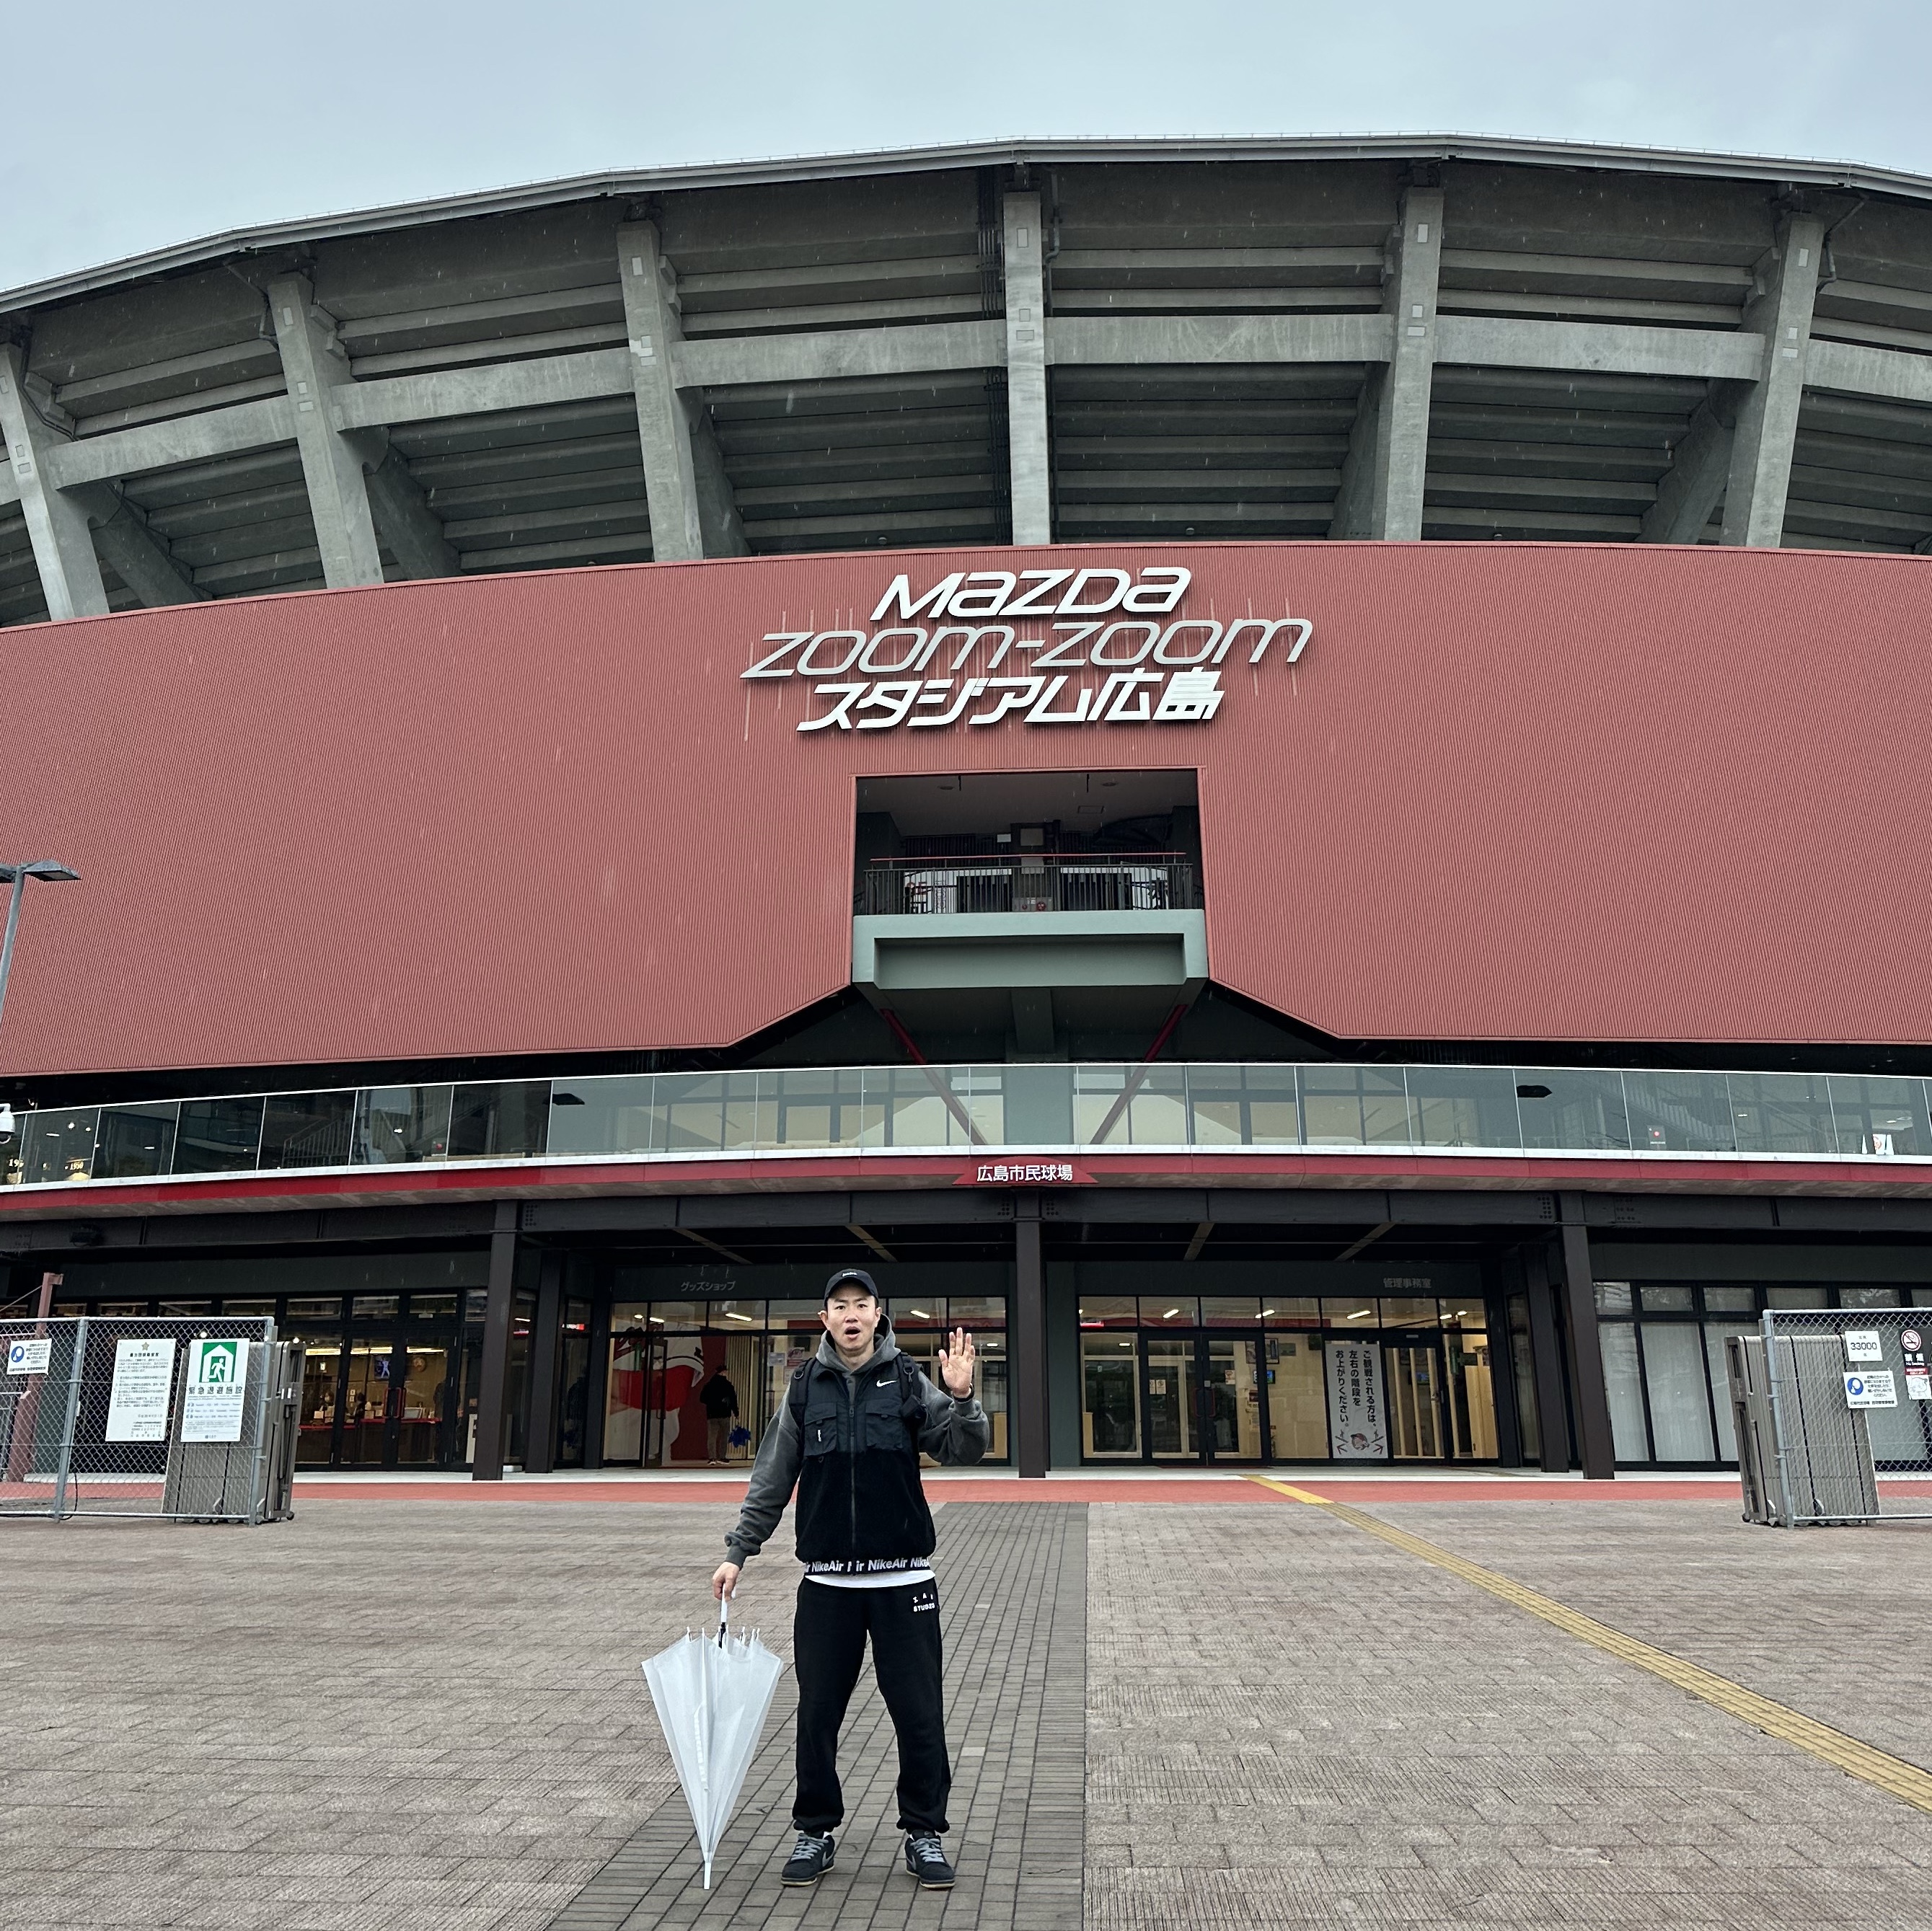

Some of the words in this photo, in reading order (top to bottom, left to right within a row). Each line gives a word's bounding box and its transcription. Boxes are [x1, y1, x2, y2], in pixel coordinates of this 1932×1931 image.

[796, 668, 1225, 732] スタジアム広島
[976, 1164, 1073, 1182] 広島市民球場
[680, 1281, 736, 1292] グッズショップ
[1851, 1342, 1877, 1351] 33000
[1349, 1350, 1361, 1407] 左右の階段を
[1336, 1350, 1349, 1427] お上がりください。
[868, 1557, 908, 1571] NikeAir
